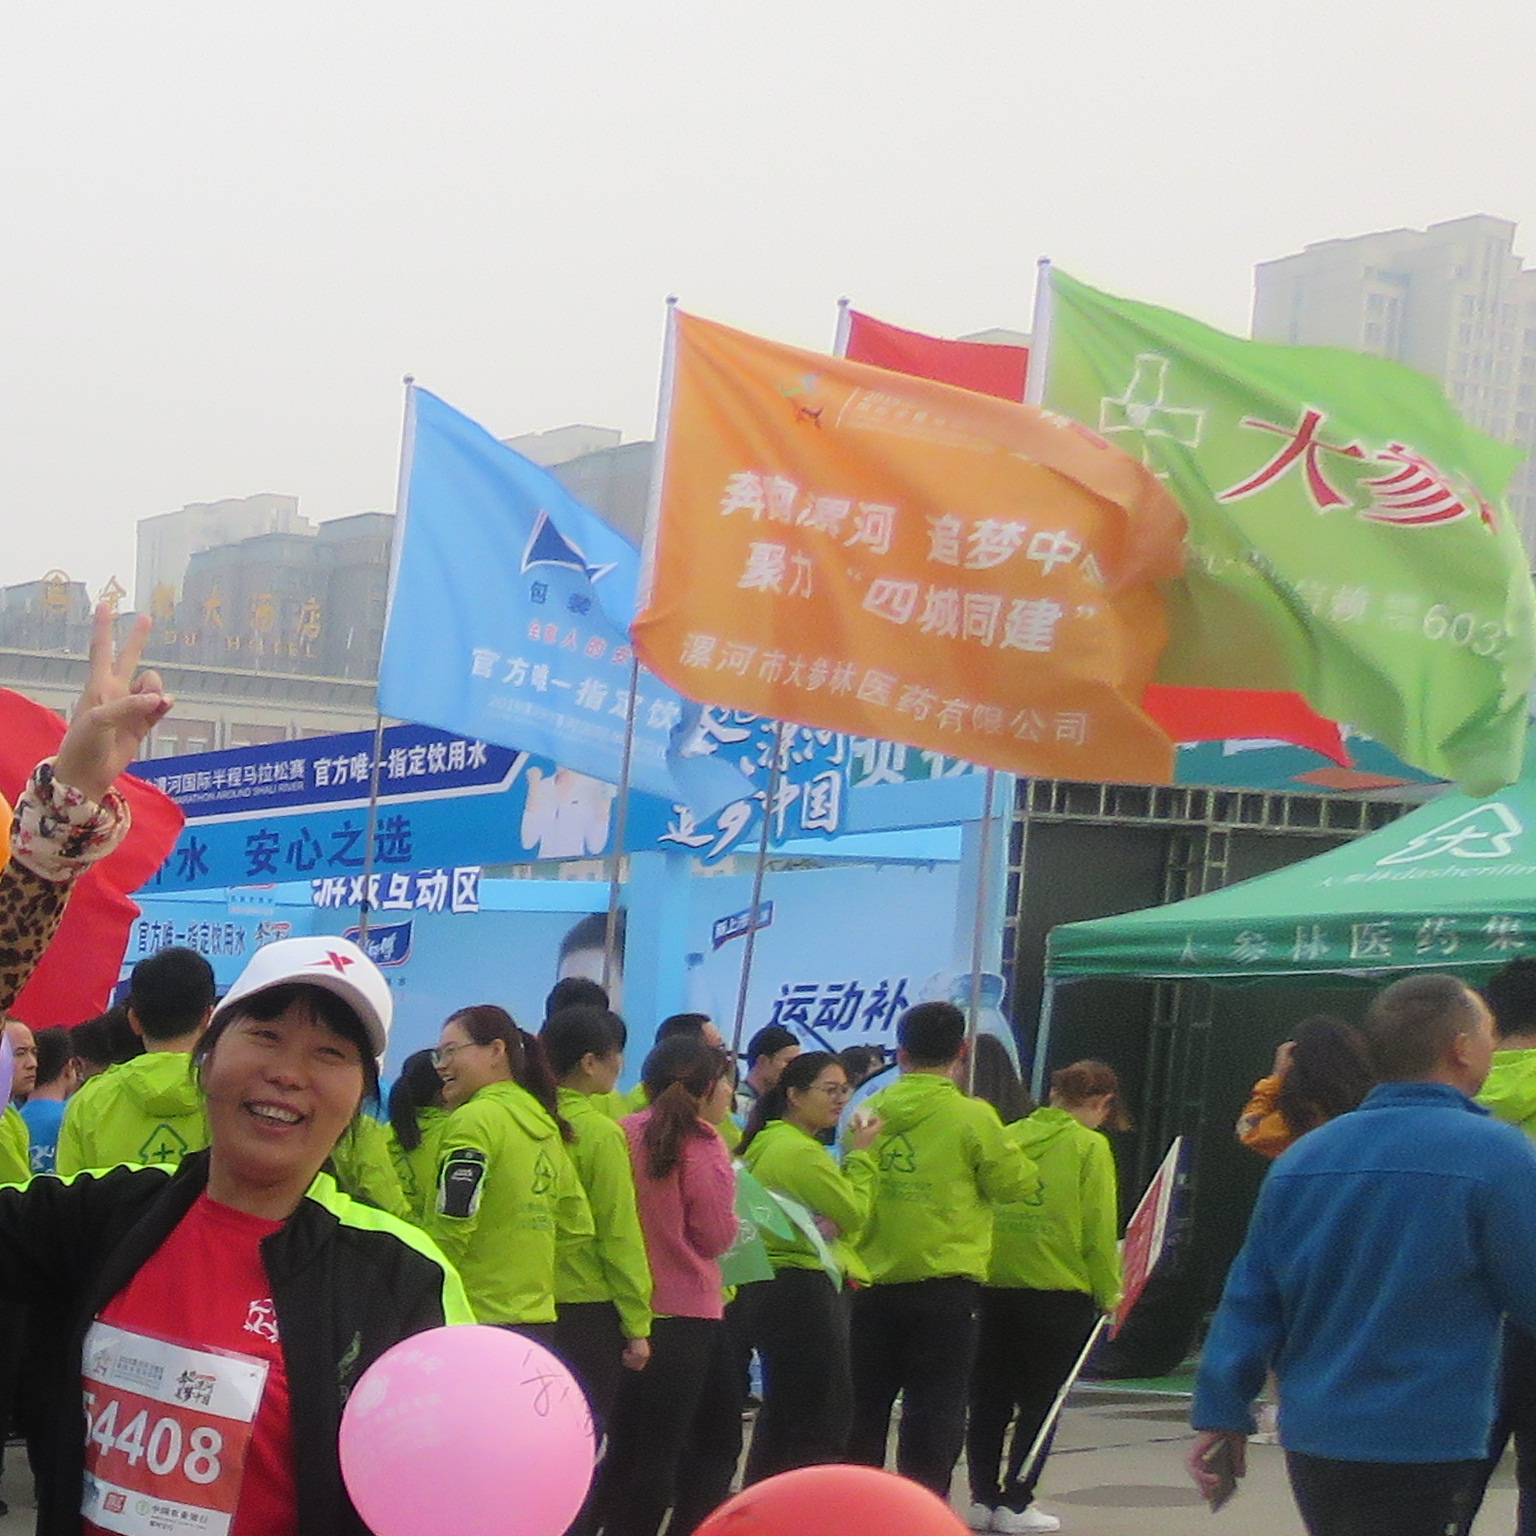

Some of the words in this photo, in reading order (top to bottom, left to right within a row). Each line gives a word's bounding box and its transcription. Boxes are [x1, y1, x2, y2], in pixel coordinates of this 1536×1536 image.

[1214, 404, 1499, 535] 大参
[678, 631, 1089, 747] 漯河市大参林医药有限公司
[313, 740, 488, 787] 官方唯一指定饮用水
[246, 815, 413, 876] 安心之选
[311, 866, 482, 913] 游戏互动区
[772, 977, 910, 1034] 运动补
